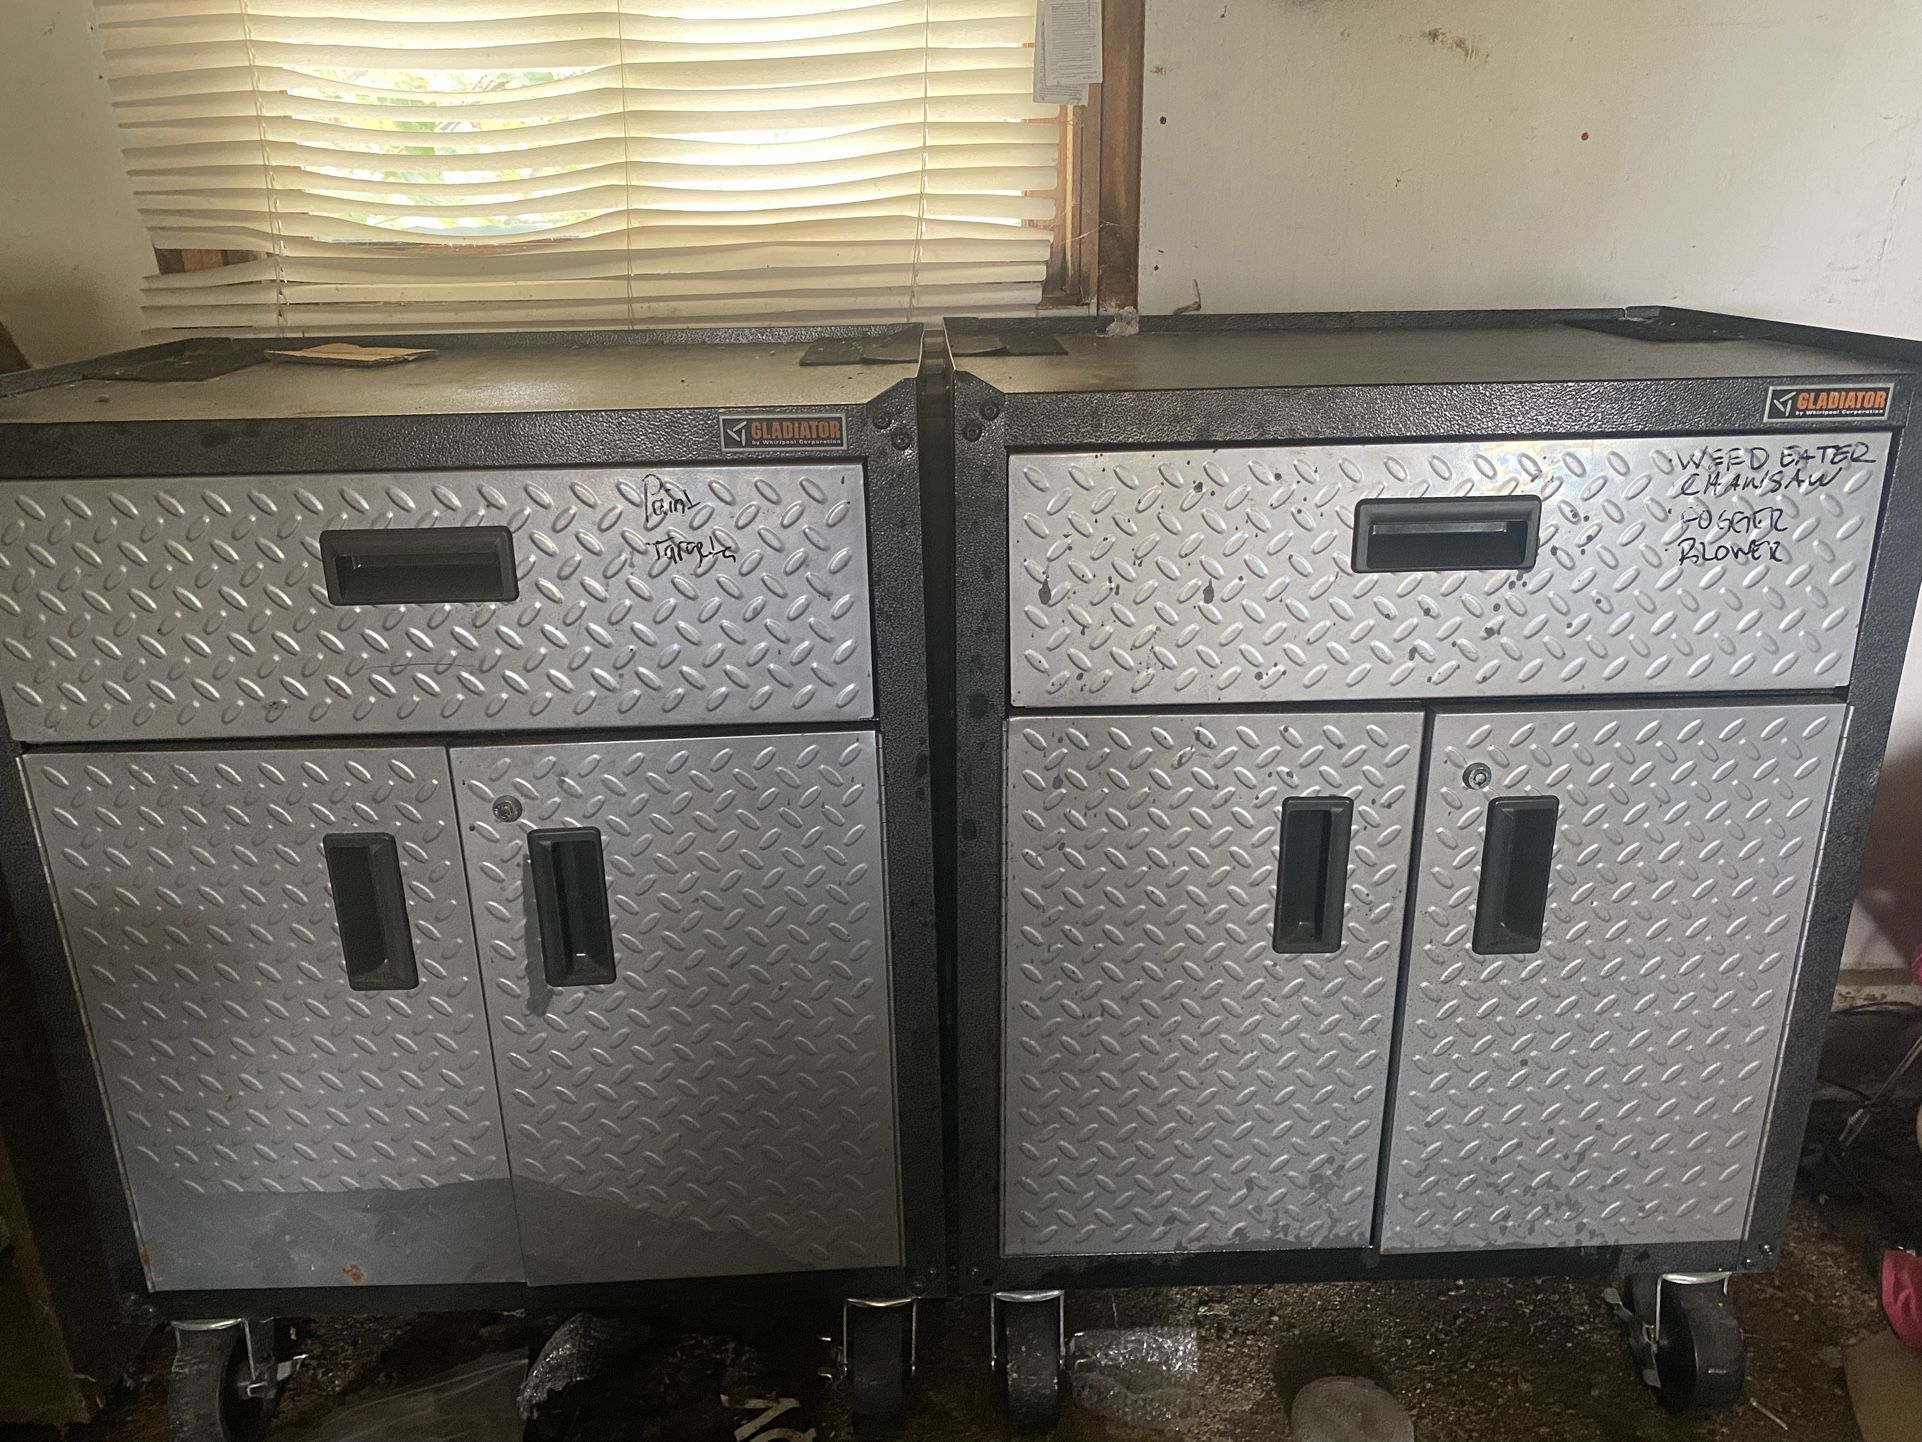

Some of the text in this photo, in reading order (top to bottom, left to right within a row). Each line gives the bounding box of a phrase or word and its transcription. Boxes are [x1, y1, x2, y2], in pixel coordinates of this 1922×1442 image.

[1796, 390, 1888, 410] GLADIATOR
[750, 420, 842, 440] GLADIATOR
[1675, 442, 1876, 471] WEED EATER
[1677, 537, 1783, 566] BLOWER
